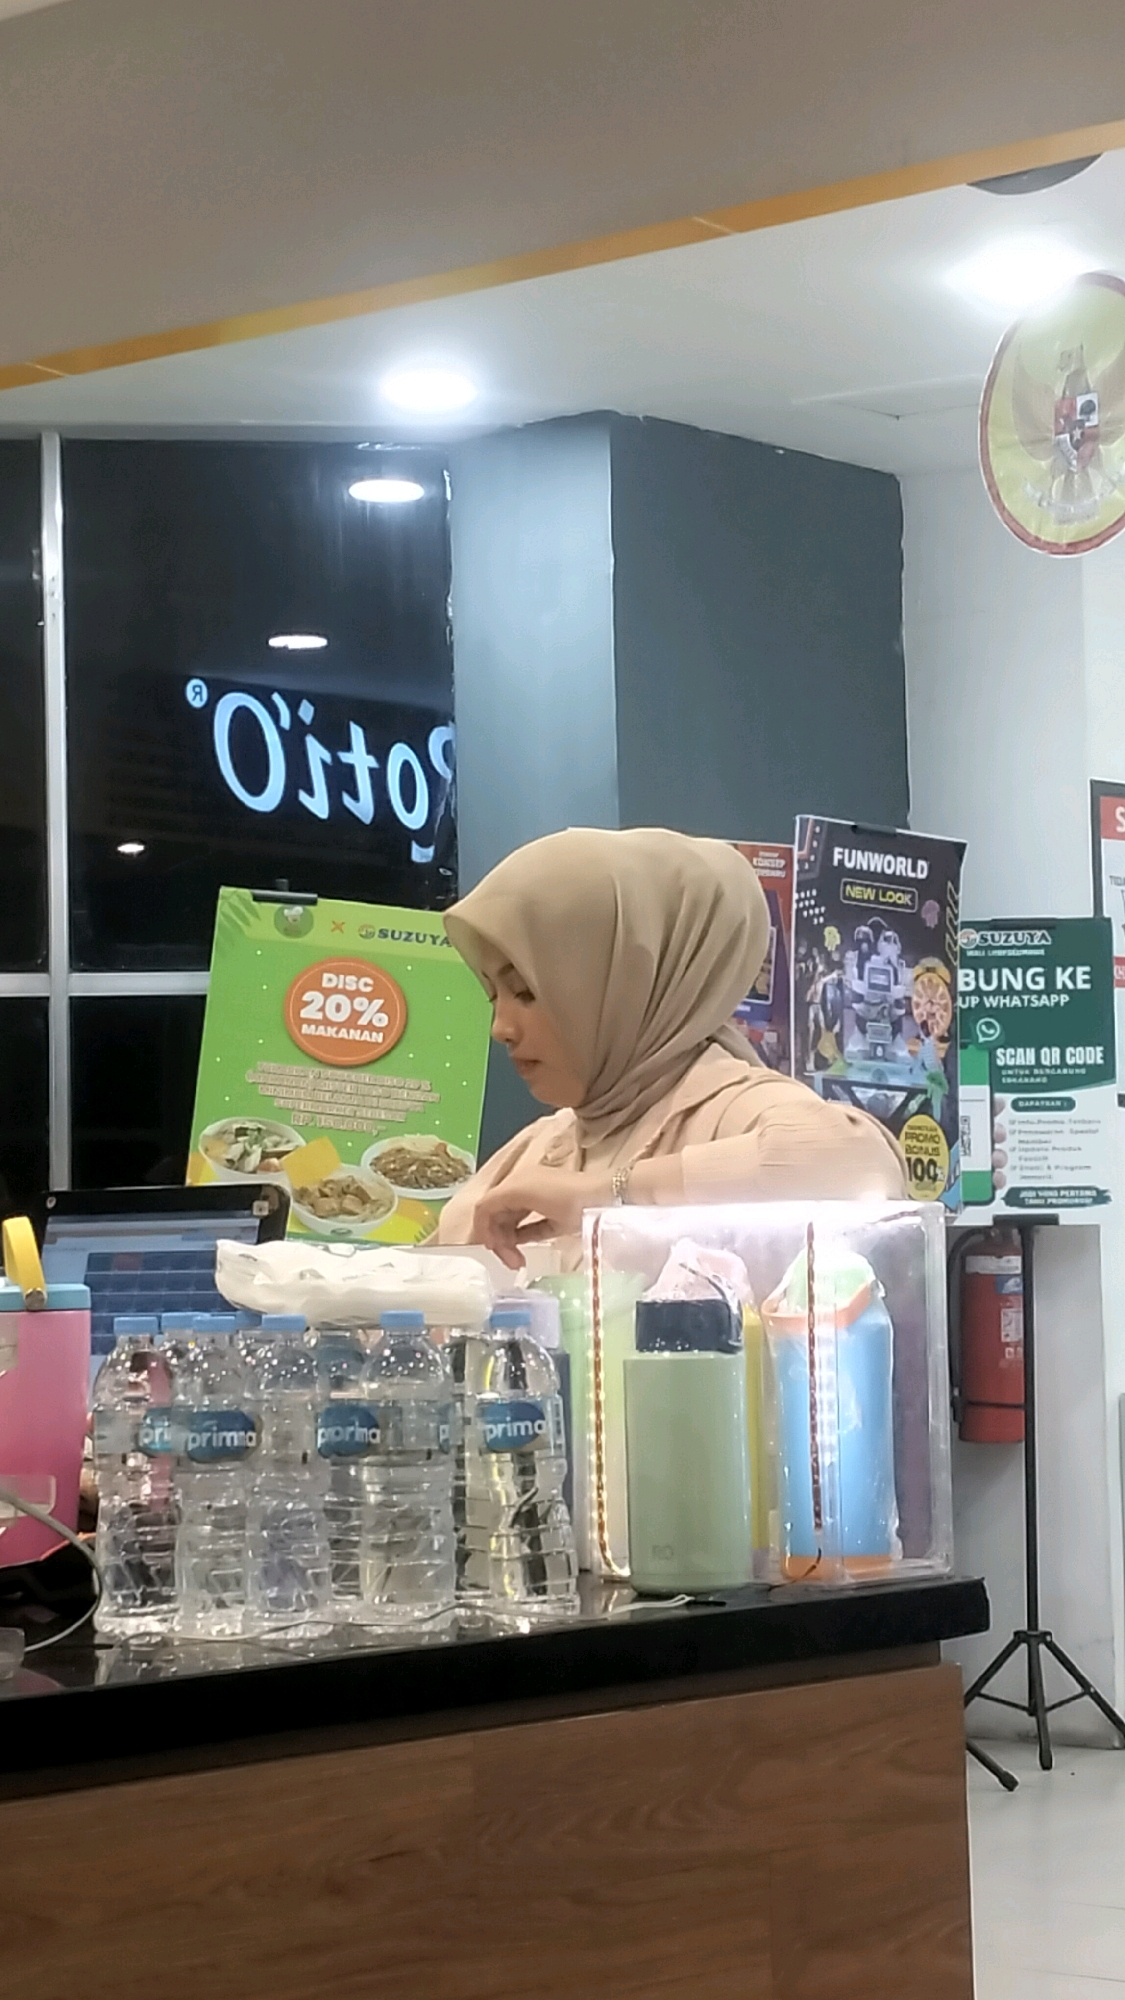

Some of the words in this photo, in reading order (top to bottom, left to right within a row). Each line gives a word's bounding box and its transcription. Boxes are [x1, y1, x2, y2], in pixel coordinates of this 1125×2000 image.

[832, 847, 929, 879] FUNWORLD
[845, 885, 876, 901] NEW
[879, 889, 912, 906] LOOK
[378, 927, 453, 948] SUZUYA
[978, 930, 1052, 946] SUZUYA
[321, 972, 374, 993] DISC
[1056, 966, 1092, 990] KE
[299, 990, 389, 1028] 20%
[983, 994, 1070, 1009] WHATSAPP
[301, 1023, 384, 1044] MAKANAN
[996, 1047, 1036, 1066] SCAN
[1041, 1047, 1061, 1066] QR
[1065, 1046, 1105, 1065] CODE
[186, 1425, 257, 1451] prima
[486, 1416, 546, 1443] prima
